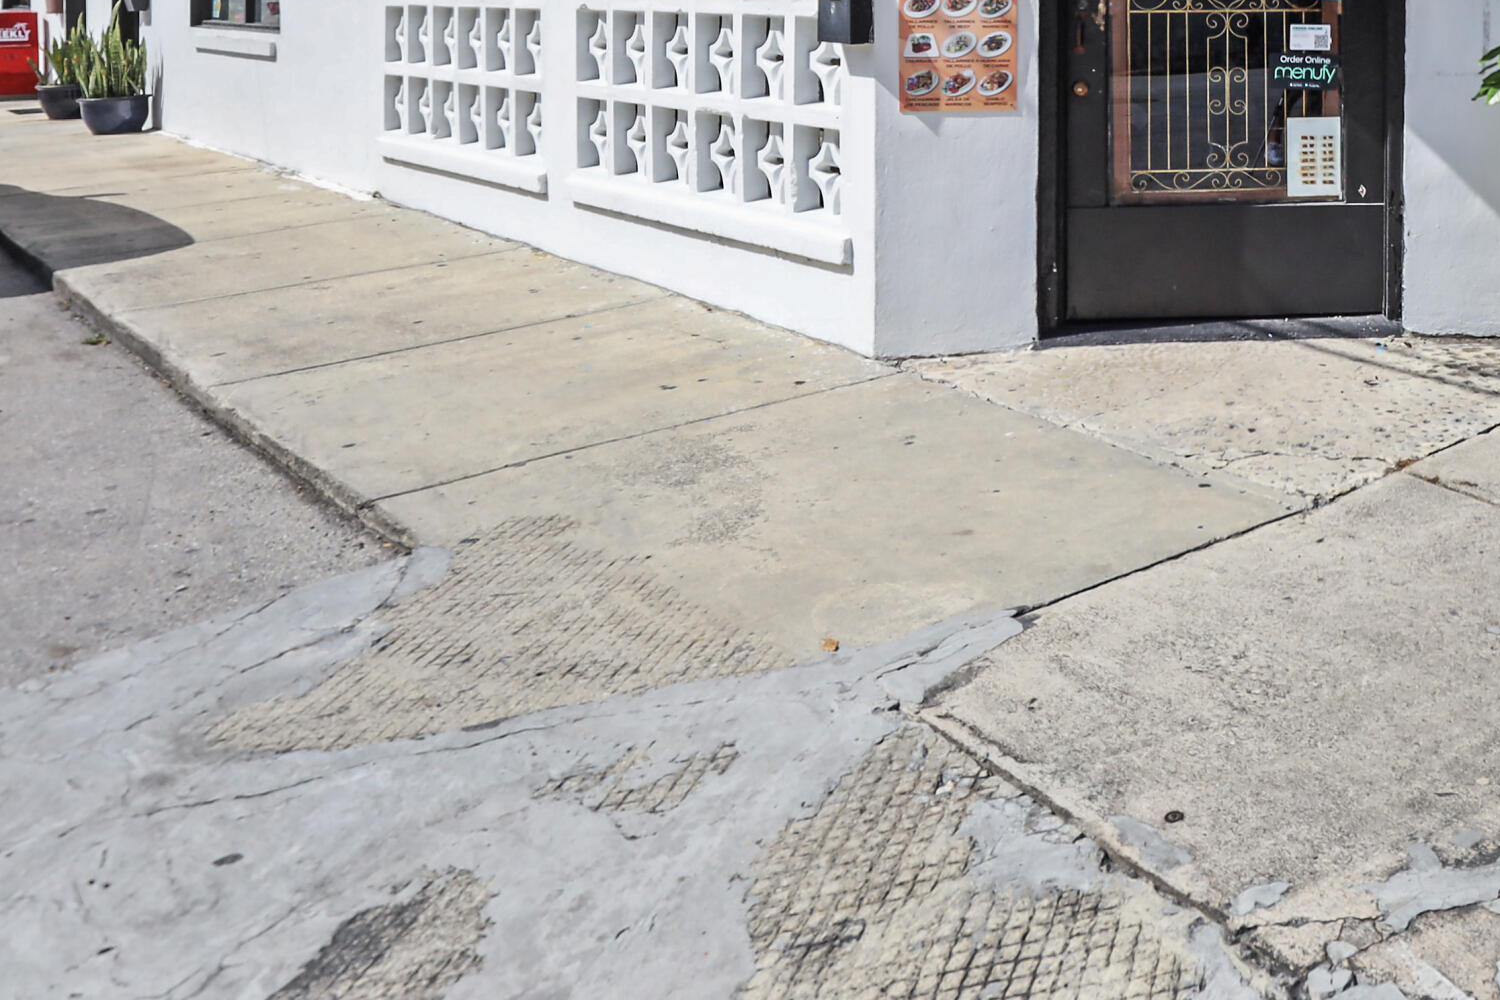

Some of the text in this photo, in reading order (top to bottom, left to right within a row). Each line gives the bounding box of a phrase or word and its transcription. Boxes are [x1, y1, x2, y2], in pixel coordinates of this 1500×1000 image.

[1280, 55, 1331, 64] Order Online
[1274, 64, 1336, 84] menufy
